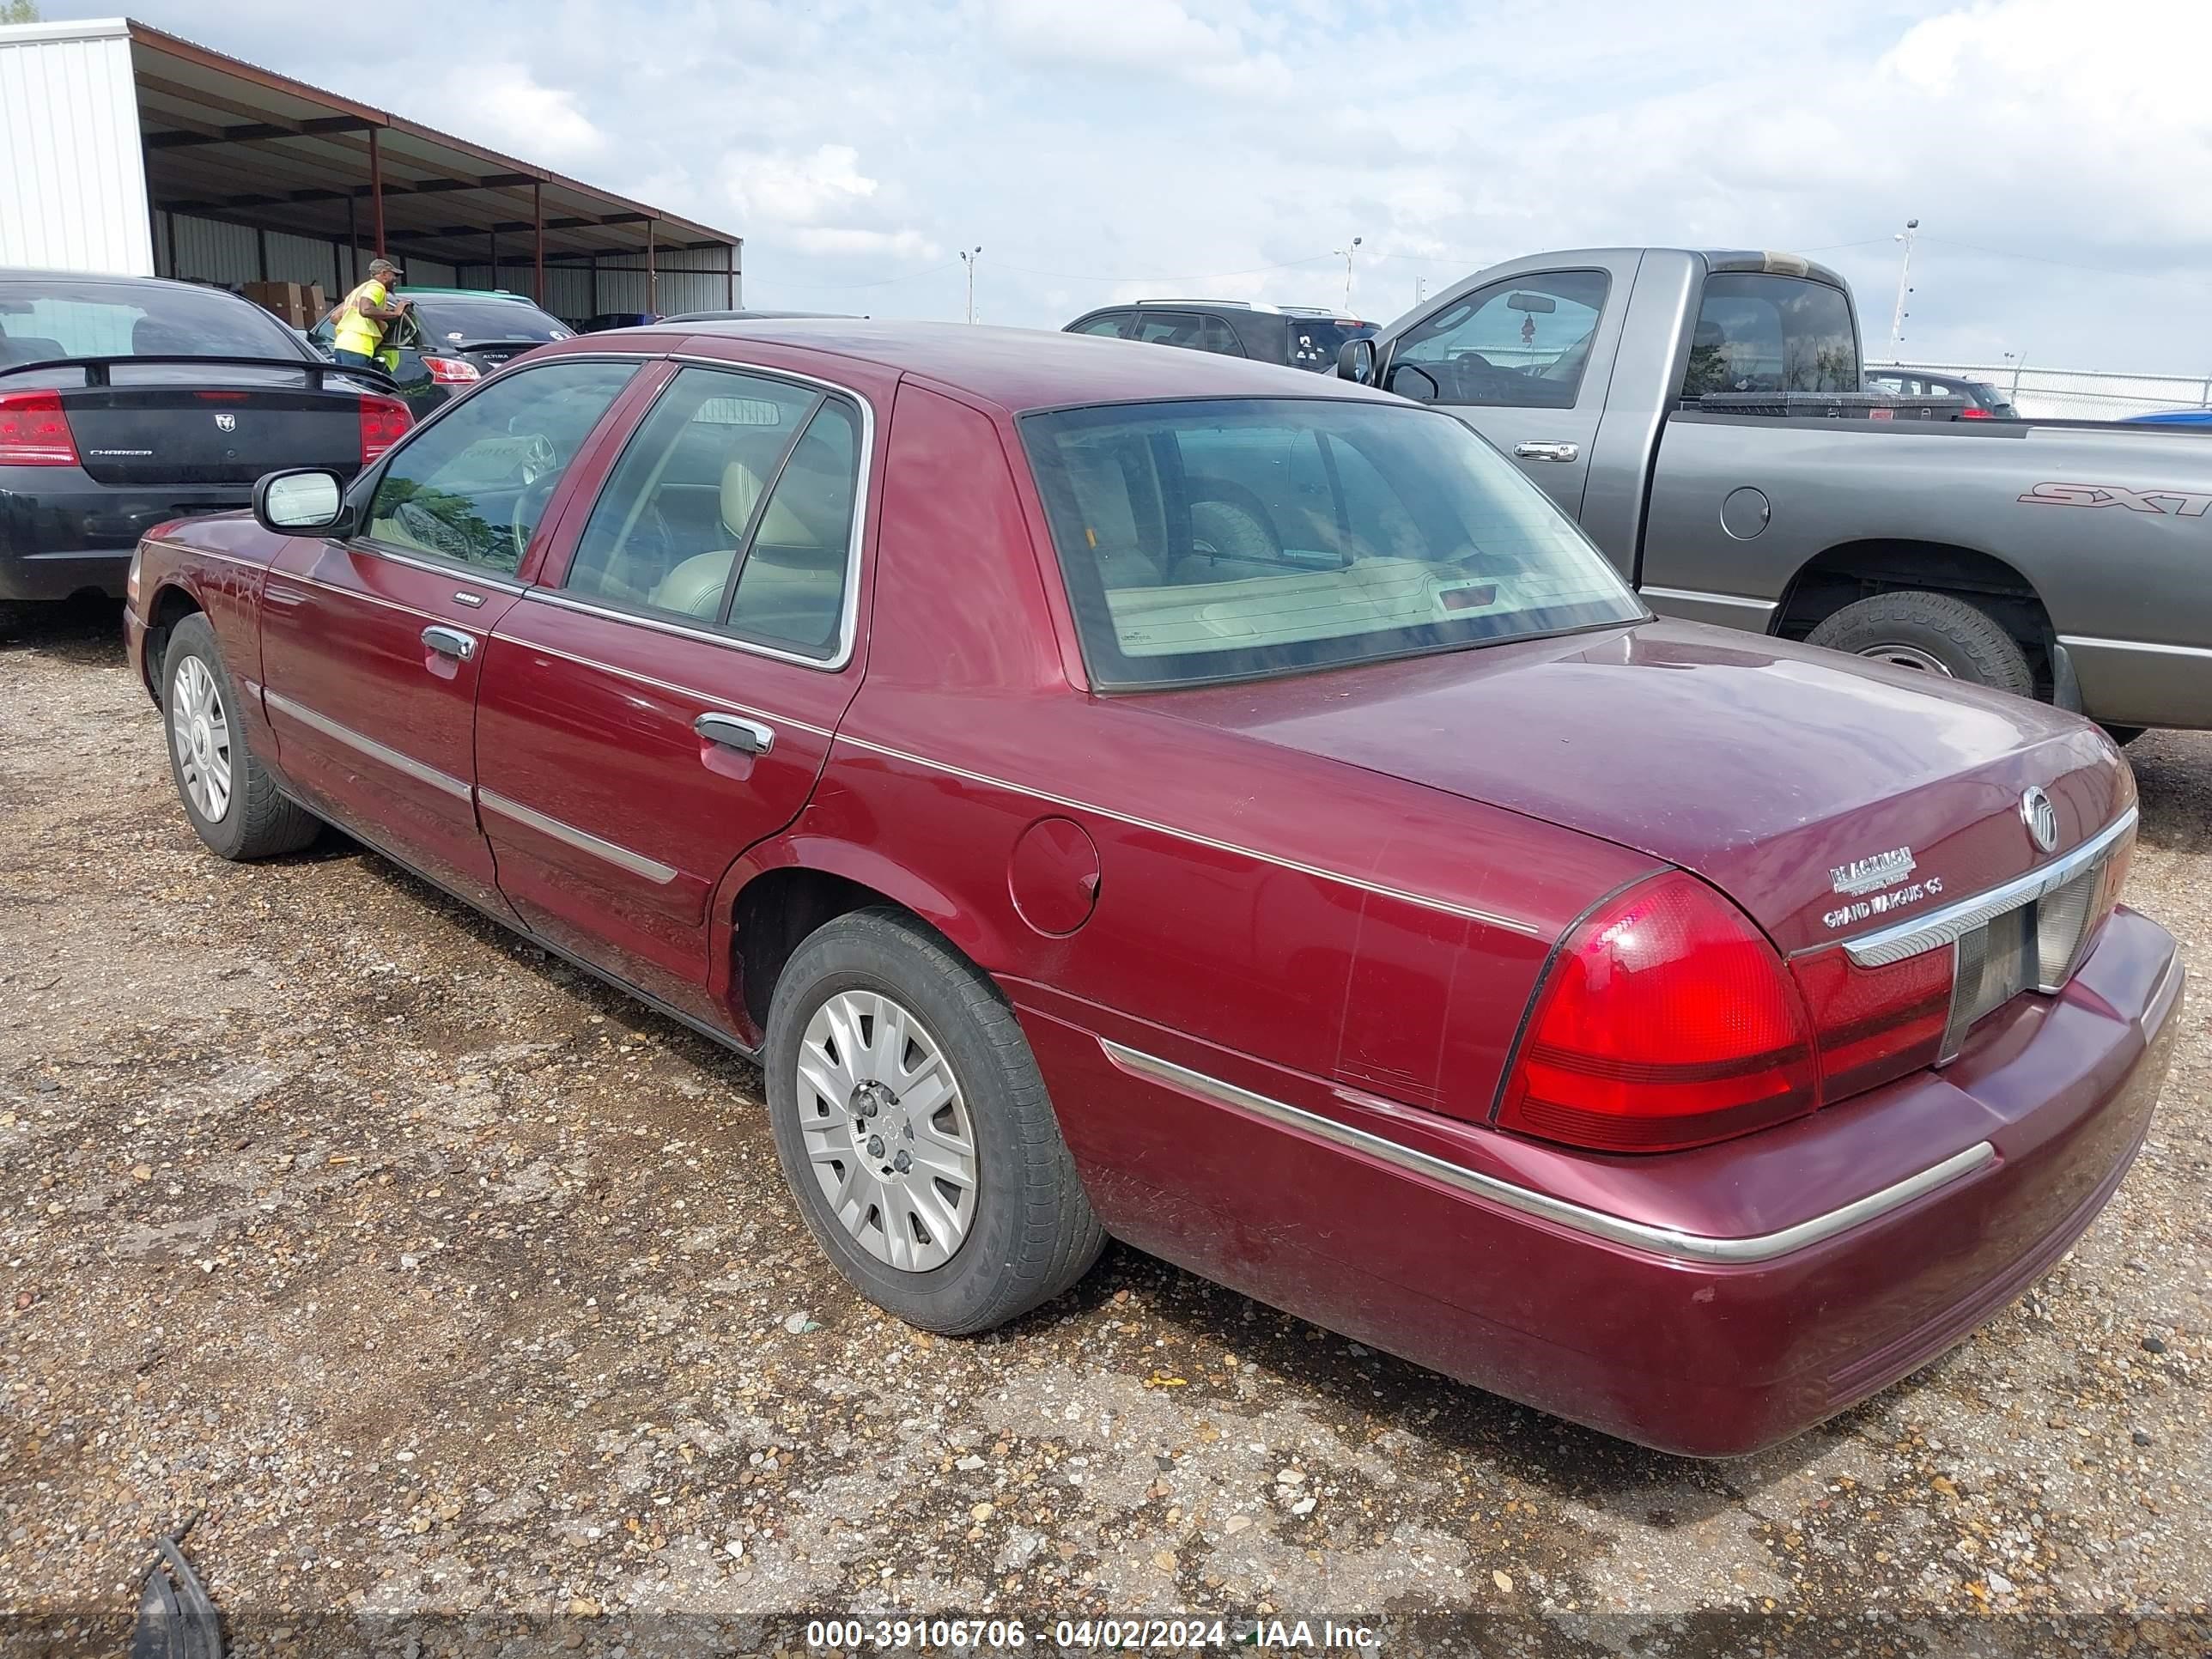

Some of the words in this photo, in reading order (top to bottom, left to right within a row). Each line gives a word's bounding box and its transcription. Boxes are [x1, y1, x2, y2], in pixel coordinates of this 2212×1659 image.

[2016, 482, 2212, 517] SXT
[1822, 902, 1870, 928] GRAND
[1871, 884, 1923, 915] MARQUIS
